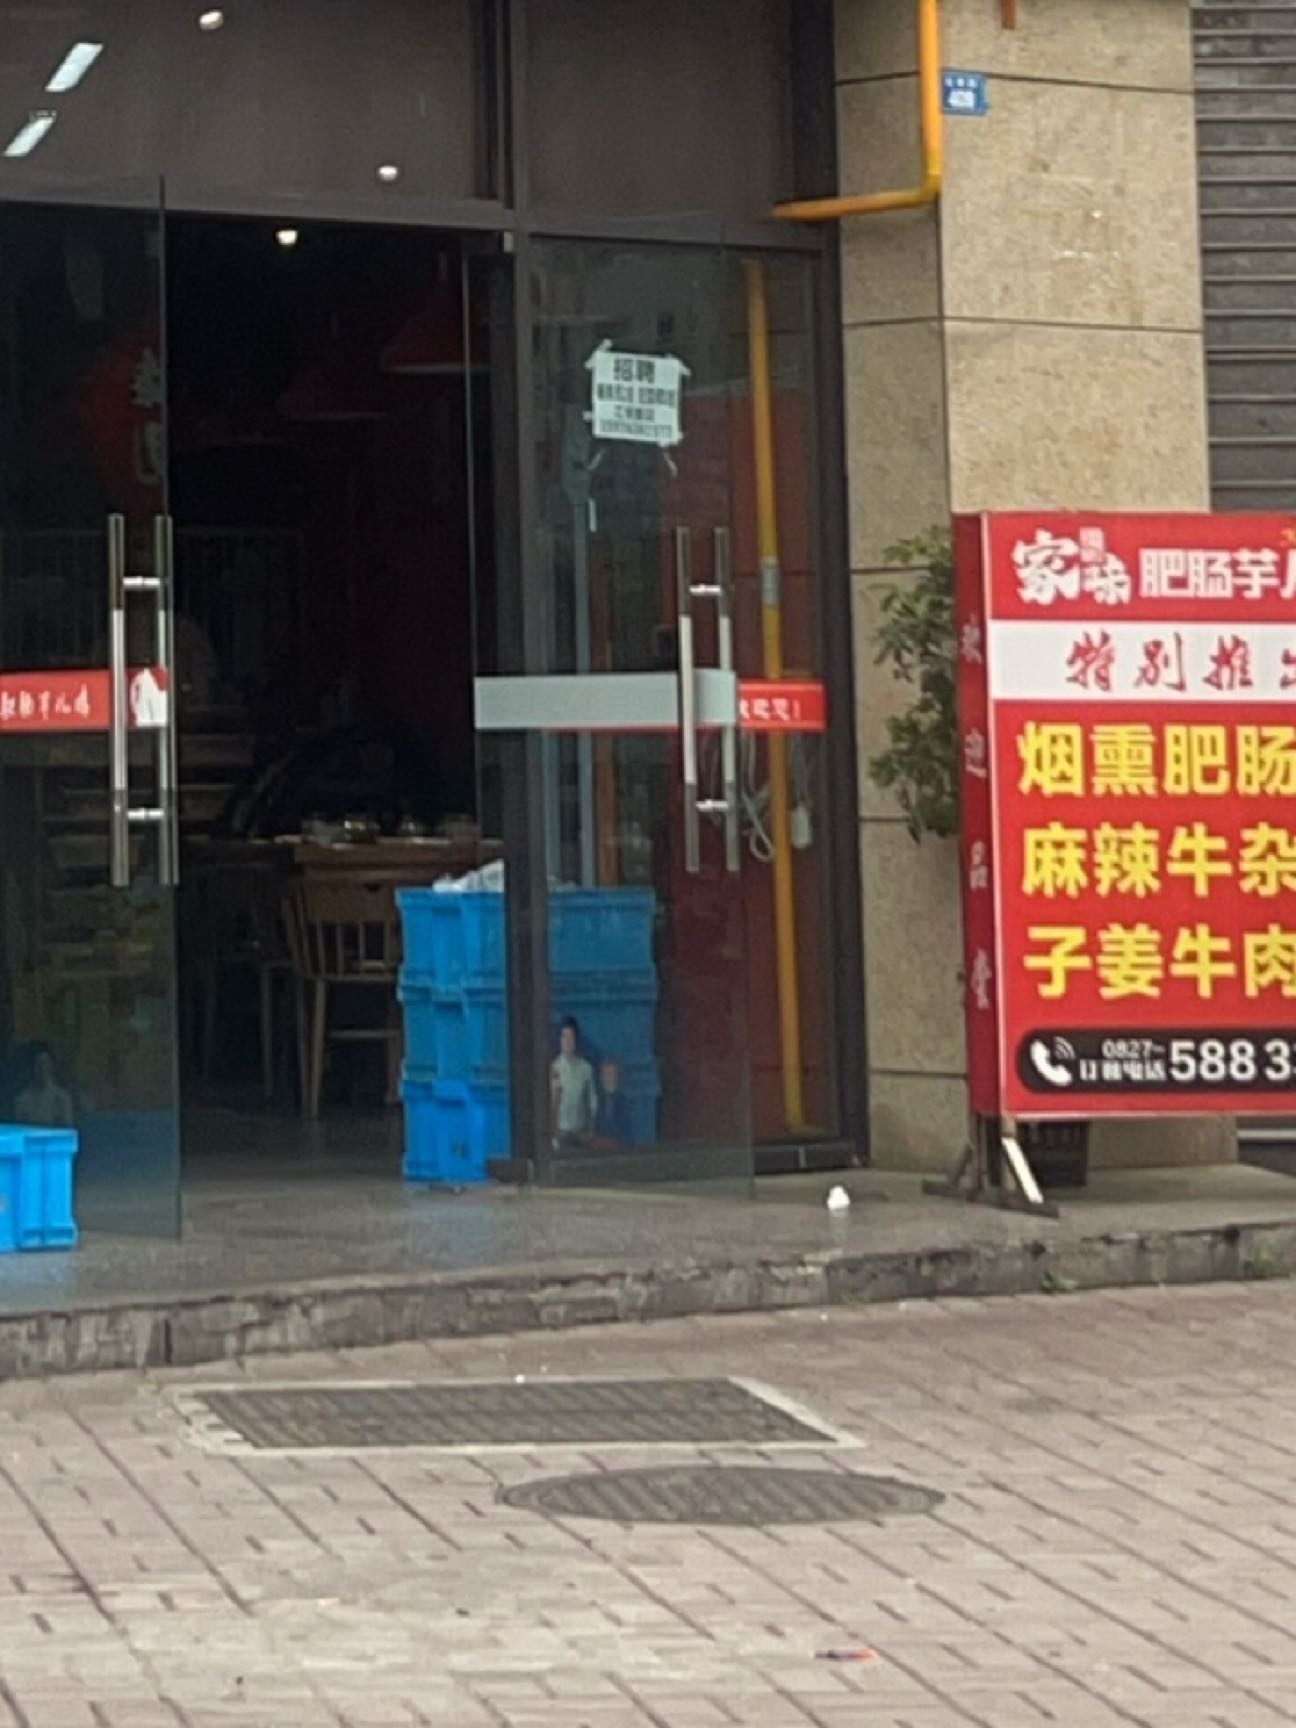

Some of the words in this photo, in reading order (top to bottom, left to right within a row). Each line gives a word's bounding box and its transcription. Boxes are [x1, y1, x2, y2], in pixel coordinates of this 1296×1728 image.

[1017, 722, 1296, 797] 烟熏肥肠
[1023, 821, 1296, 899] 麻辣牛杂
[1023, 923, 1296, 1000] 子姜牛肉
[1264, 1038, 1296, 1082] 3
